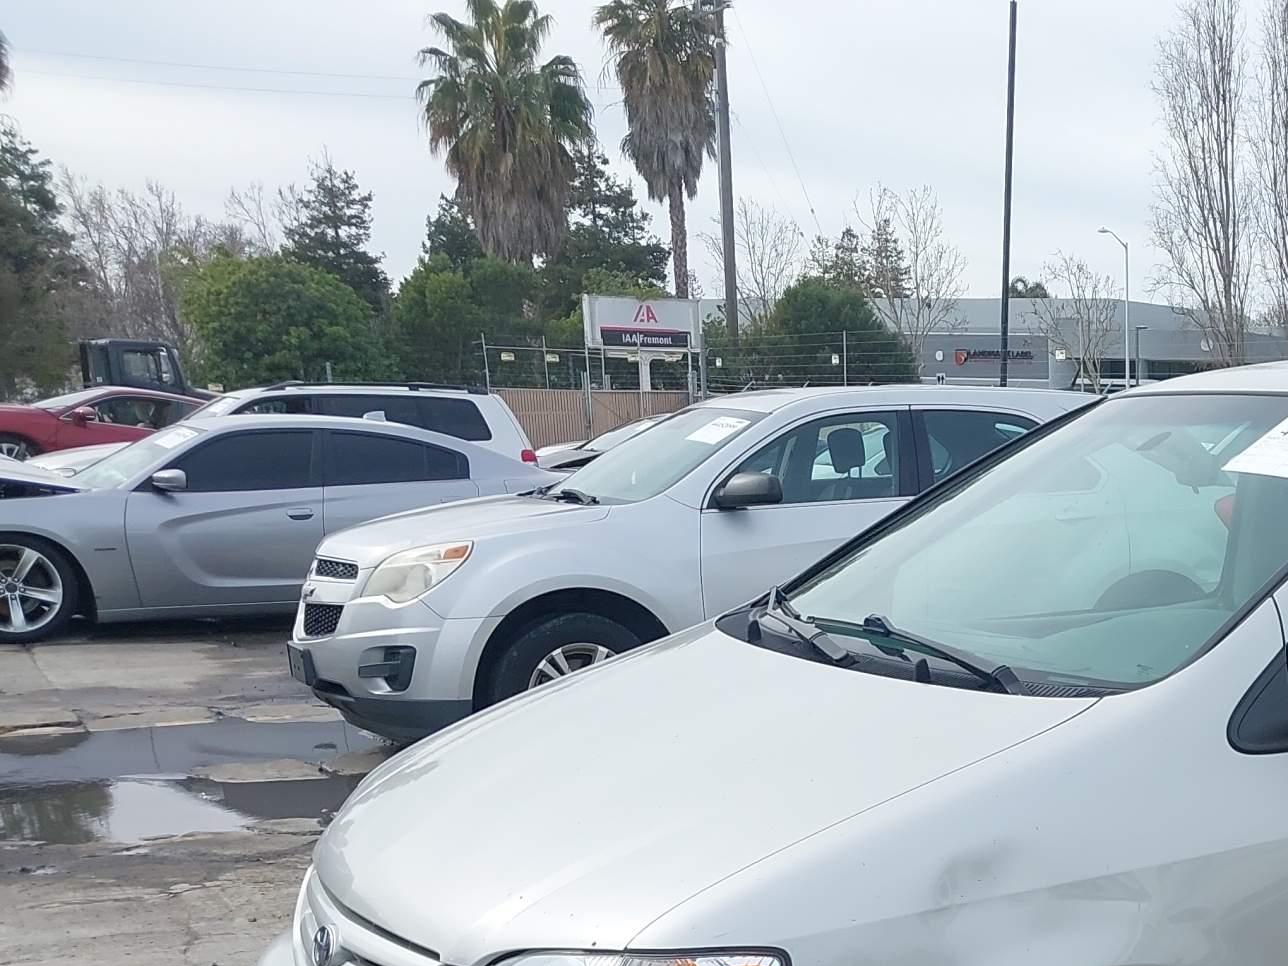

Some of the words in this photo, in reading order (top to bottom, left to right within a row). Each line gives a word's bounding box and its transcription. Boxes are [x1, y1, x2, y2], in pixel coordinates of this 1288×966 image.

[622, 333, 638, 343] IAA
[640, 334, 672, 345] Fremont
[968, 350, 1011, 358] LANDMAK
